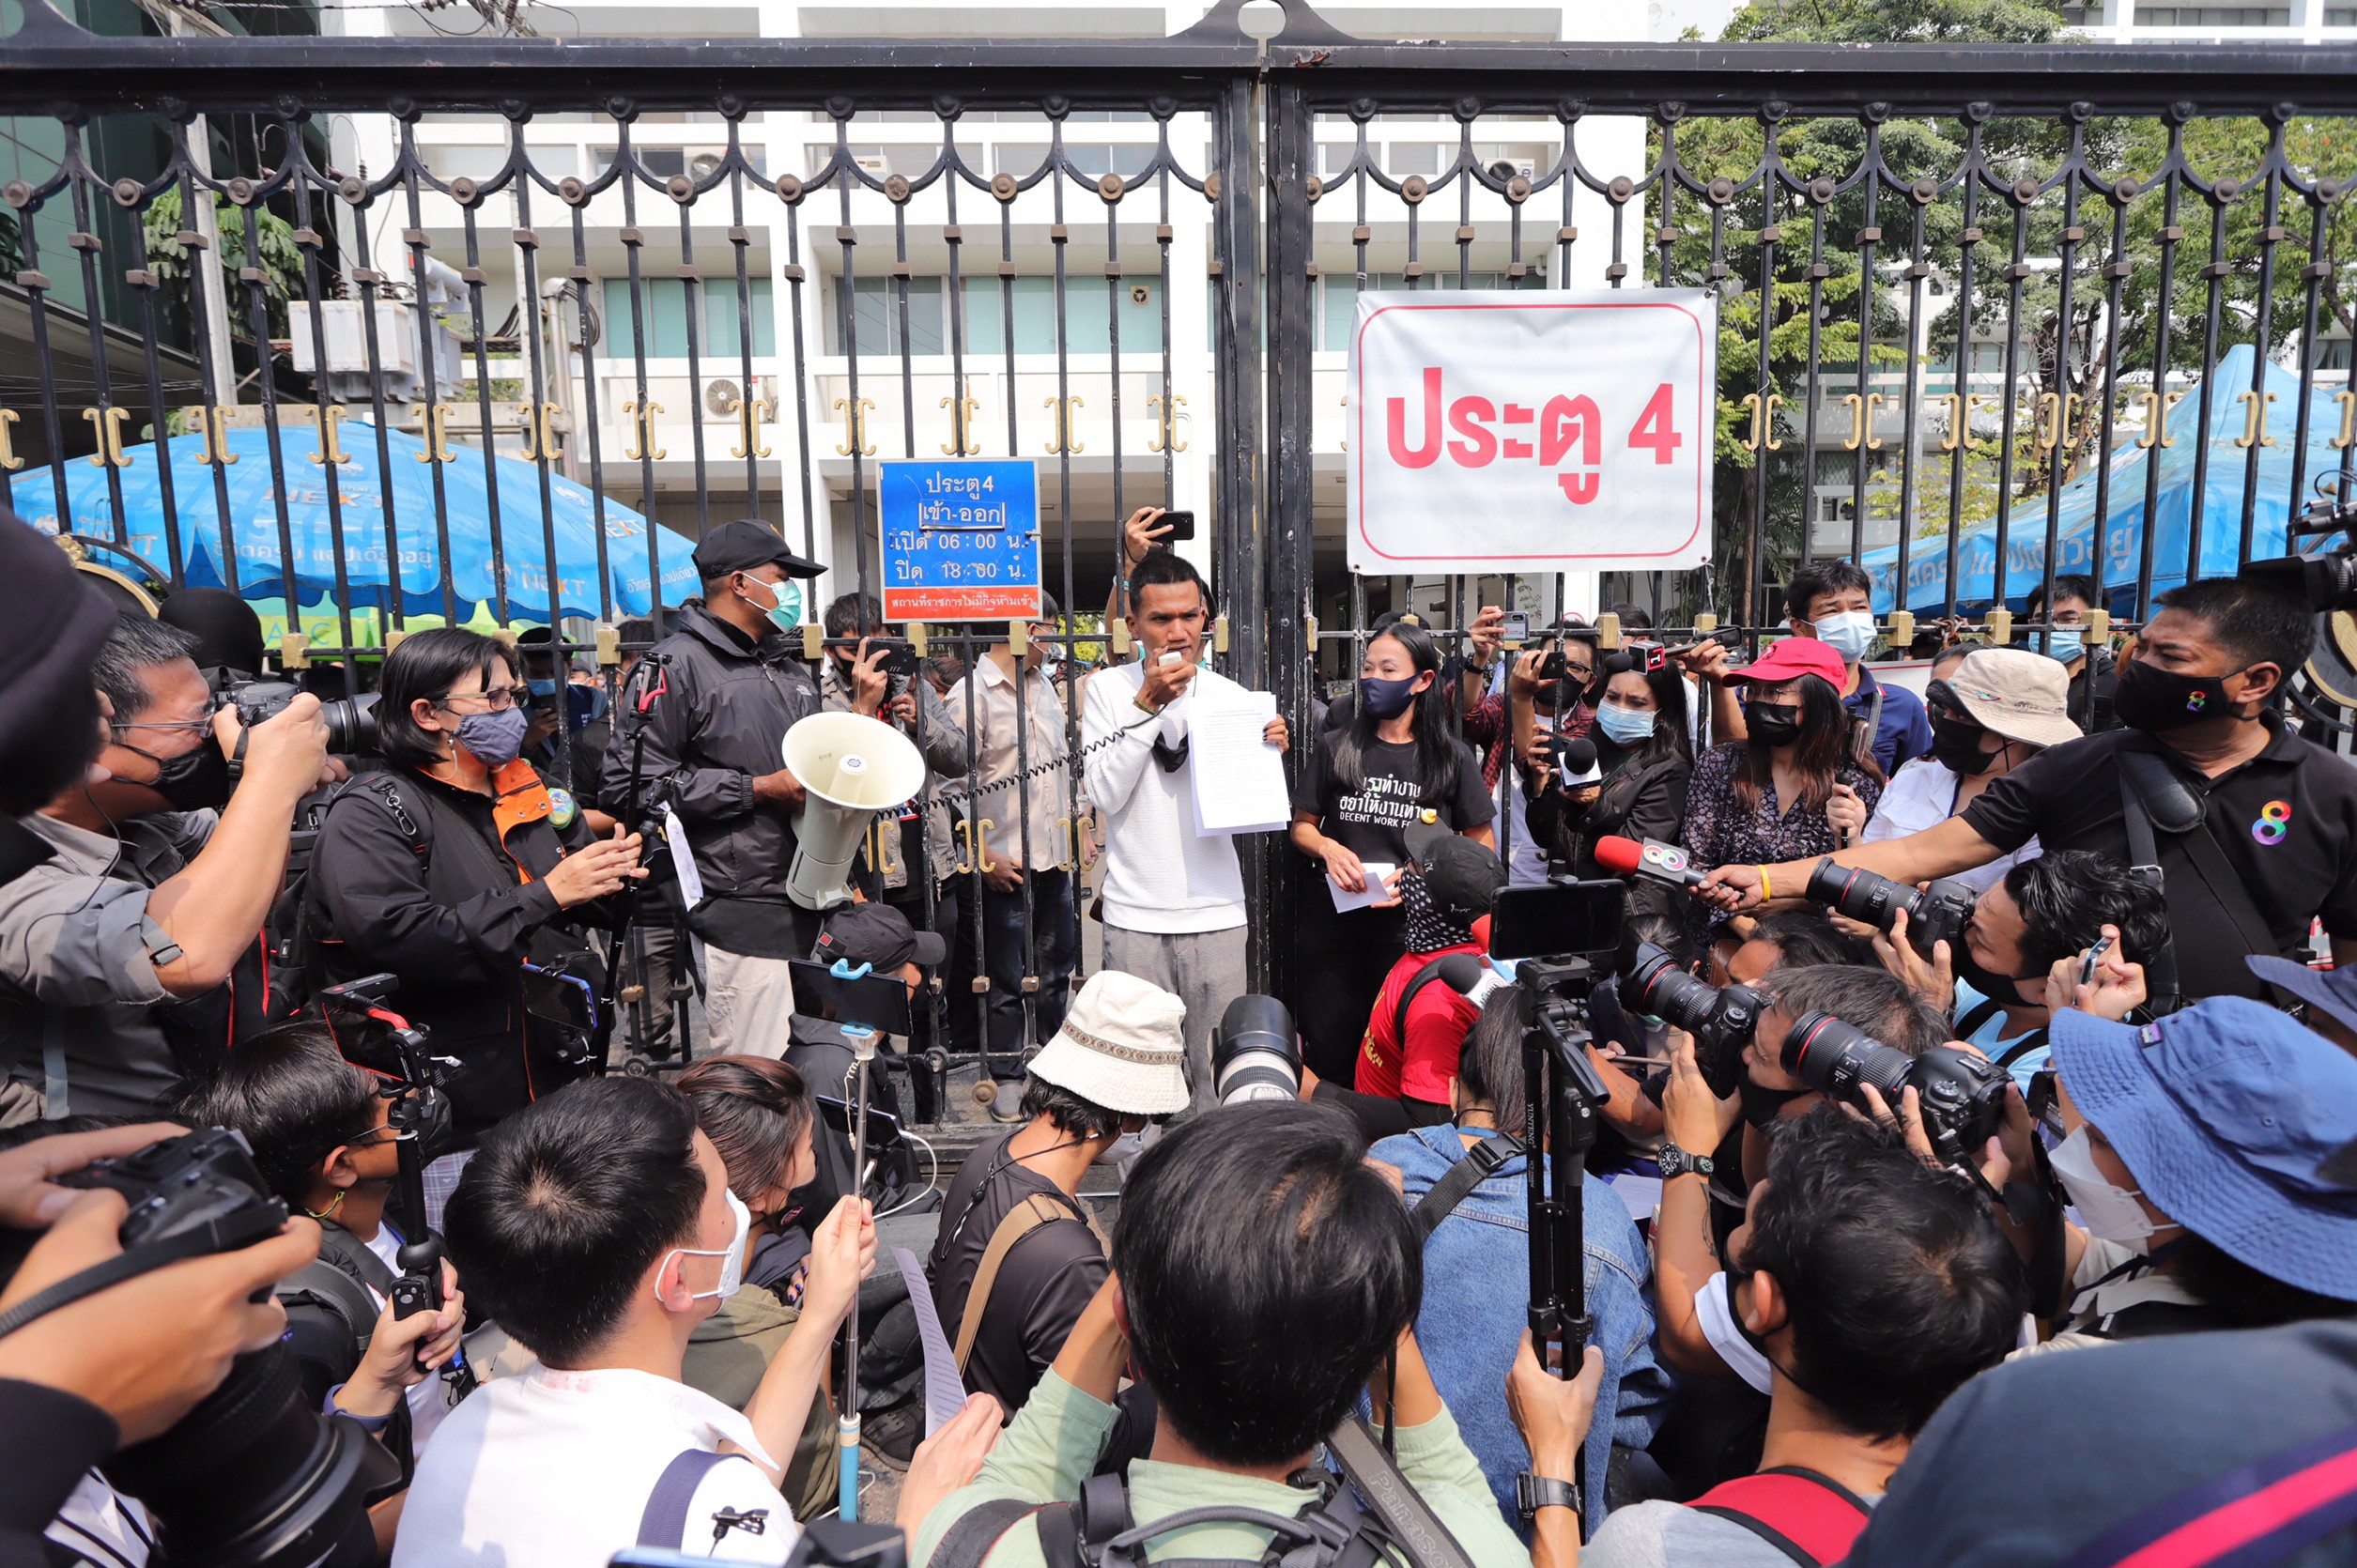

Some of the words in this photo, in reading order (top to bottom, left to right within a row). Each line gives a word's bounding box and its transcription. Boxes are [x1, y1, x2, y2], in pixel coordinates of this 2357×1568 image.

[1386, 366, 1601, 505] ประตู
[1627, 383, 1682, 465] 4
[923, 500, 1001, 523] เข้า-ออก
[894, 530, 929, 551] เปิด
[1007, 533, 1026, 548] น.
[895, 561, 923, 580] ปิด
[1008, 562, 1027, 578] น.
[1339, 811, 1372, 823] DECENT
[1373, 816, 1399, 827] WORK
[1369, 1470, 1452, 1568] Panaso
